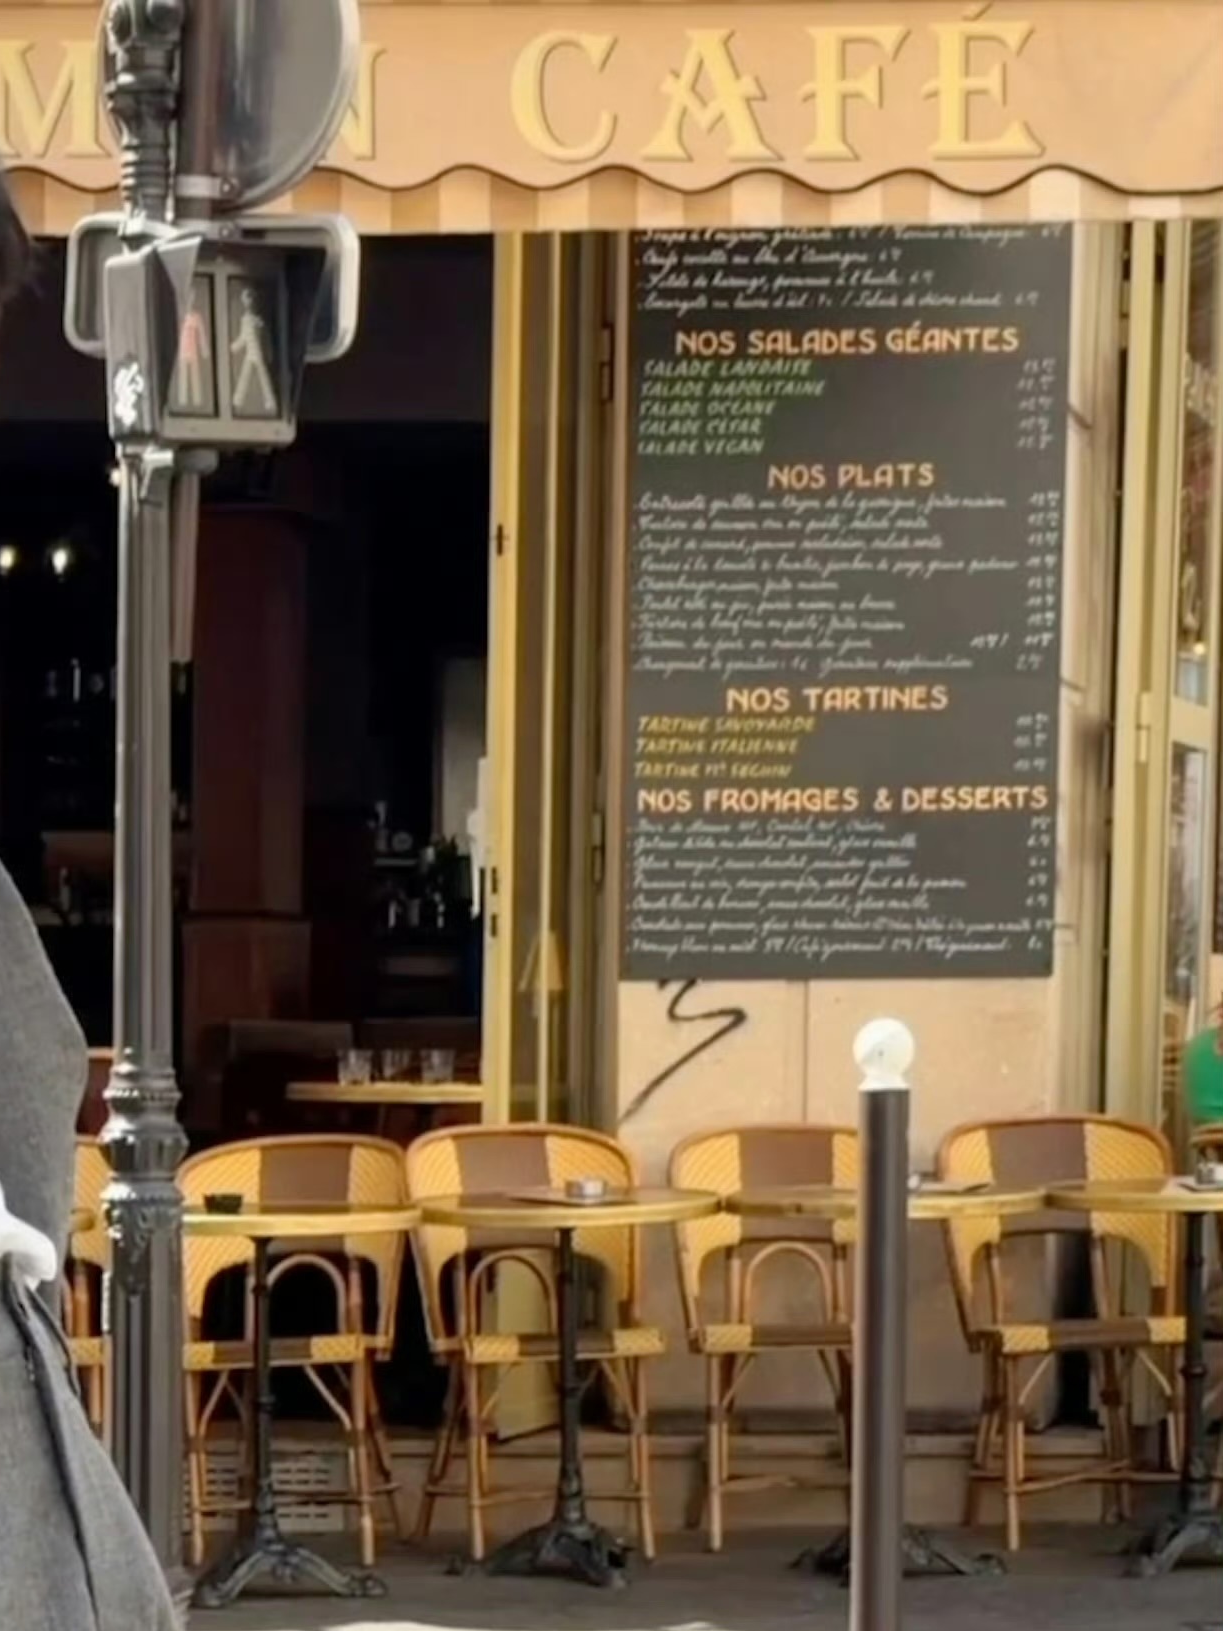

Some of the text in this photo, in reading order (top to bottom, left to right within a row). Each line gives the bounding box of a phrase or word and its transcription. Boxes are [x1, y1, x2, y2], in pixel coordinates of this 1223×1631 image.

[509, 6, 1046, 162] CAFÉ
[675, 320, 1020, 356] NOS SALADES GÉANTES
[643, 359, 714, 377] SALADE
[767, 462, 935, 490] NOS PLATS
[726, 685, 949, 713] NOS TARTINES
[637, 715, 710, 733] TARTINE
[635, 736, 707, 754] TARTINE
[634, 760, 701, 778] TARTINE
[637, 785, 1049, 813] NOS FROMAGES & DESSERTS
